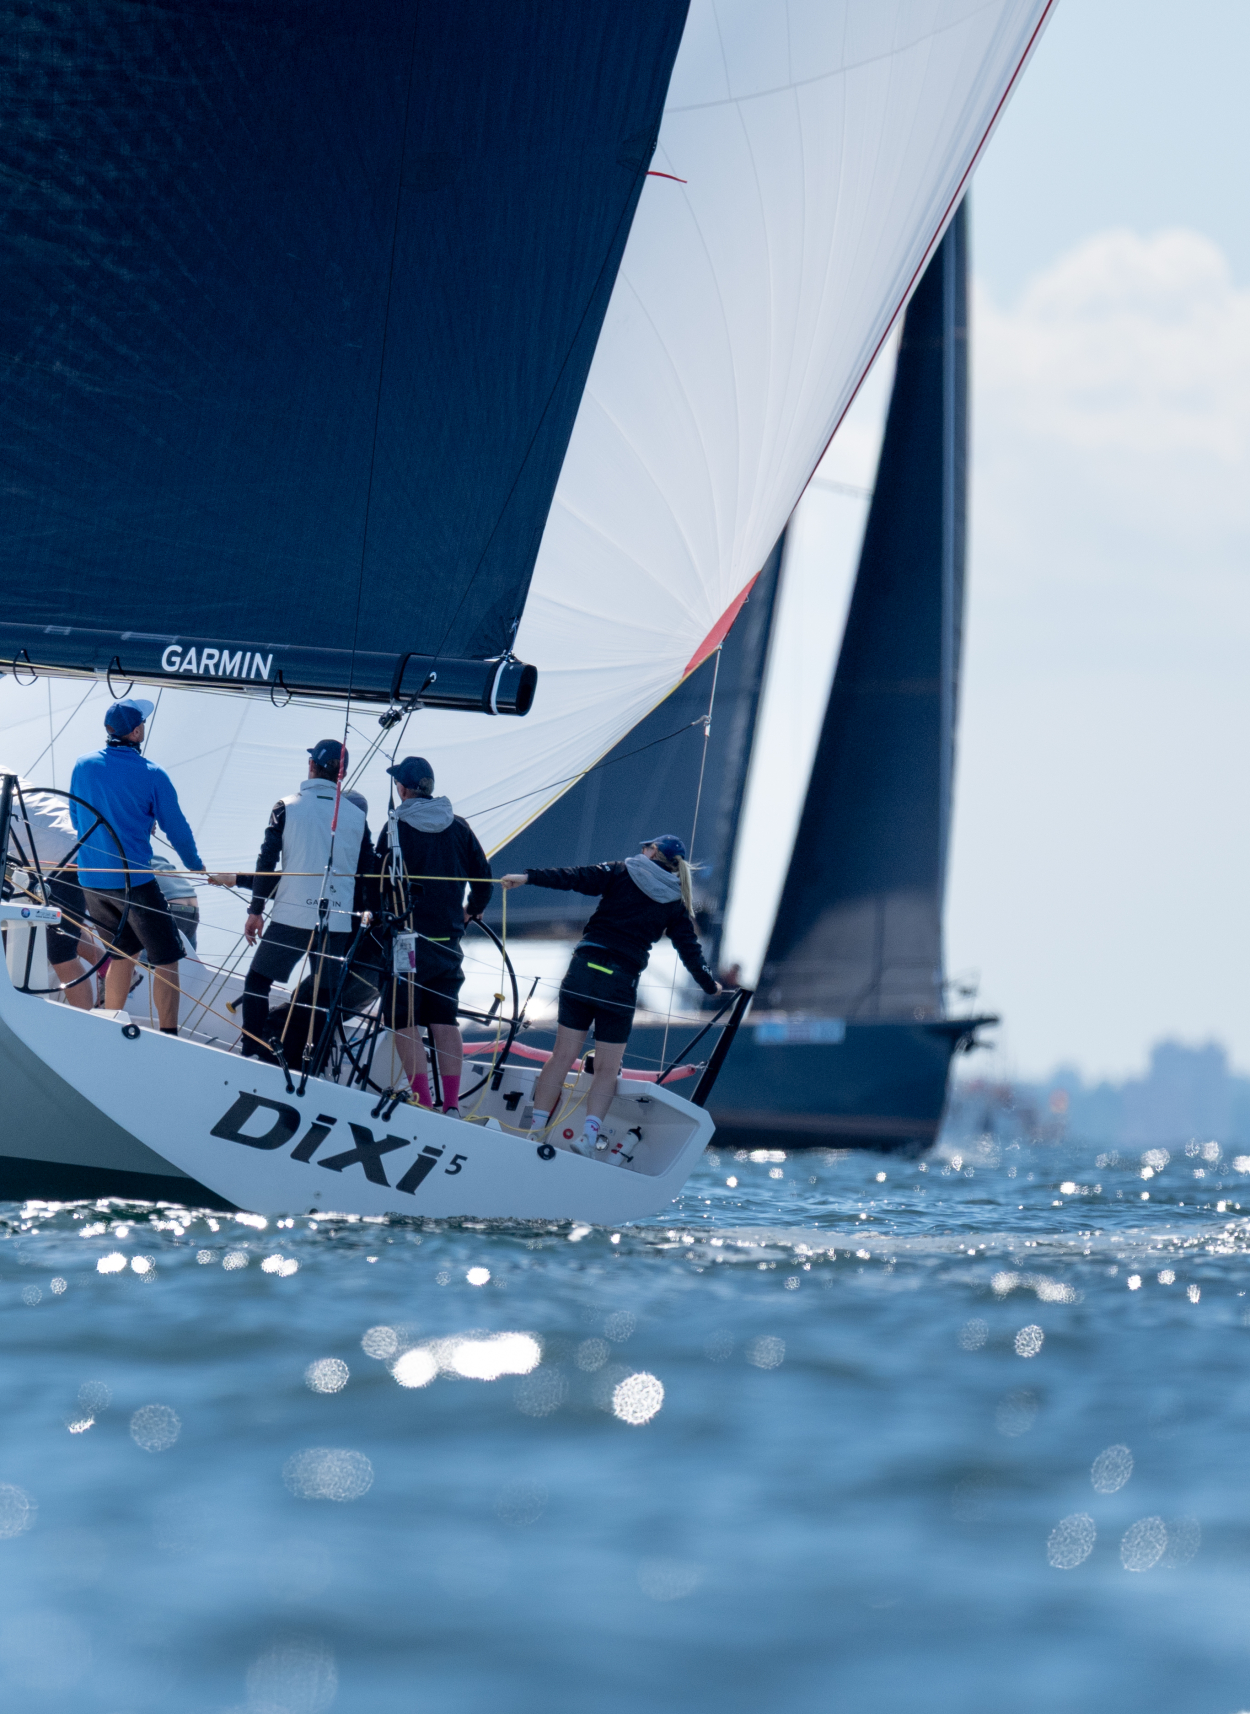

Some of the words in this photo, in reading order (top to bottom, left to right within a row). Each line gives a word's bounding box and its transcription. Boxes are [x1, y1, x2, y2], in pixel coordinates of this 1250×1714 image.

[161, 644, 273, 680] GARMIN
[306, 898, 342, 908] GAIN
[444, 1153, 468, 1176] 5
